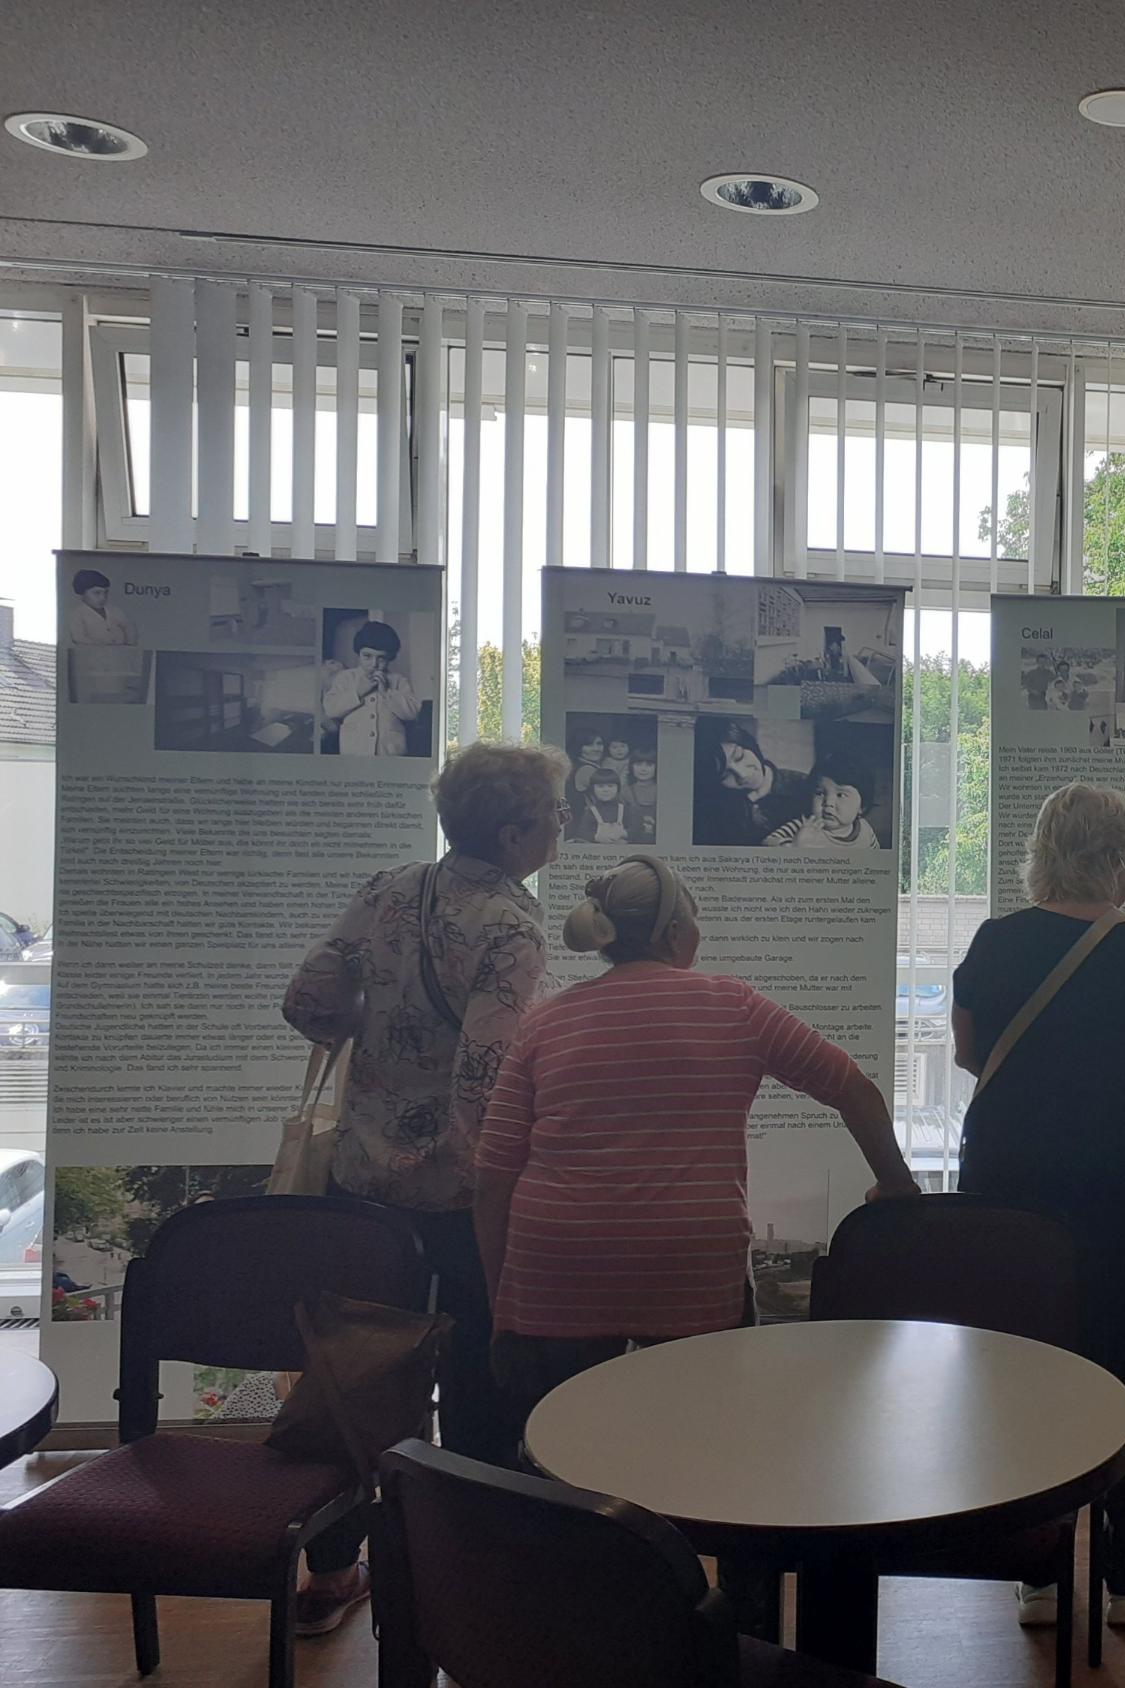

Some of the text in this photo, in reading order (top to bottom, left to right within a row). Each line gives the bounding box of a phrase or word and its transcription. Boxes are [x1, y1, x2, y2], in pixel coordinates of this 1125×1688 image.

[124, 582, 171, 598] Dunya
[608, 592, 652, 606] Yavuz
[1021, 627, 1054, 640] Celal
[782, 856, 802, 864] nach
[549, 862, 561, 870] Ich
[676, 865, 701, 873] Leben
